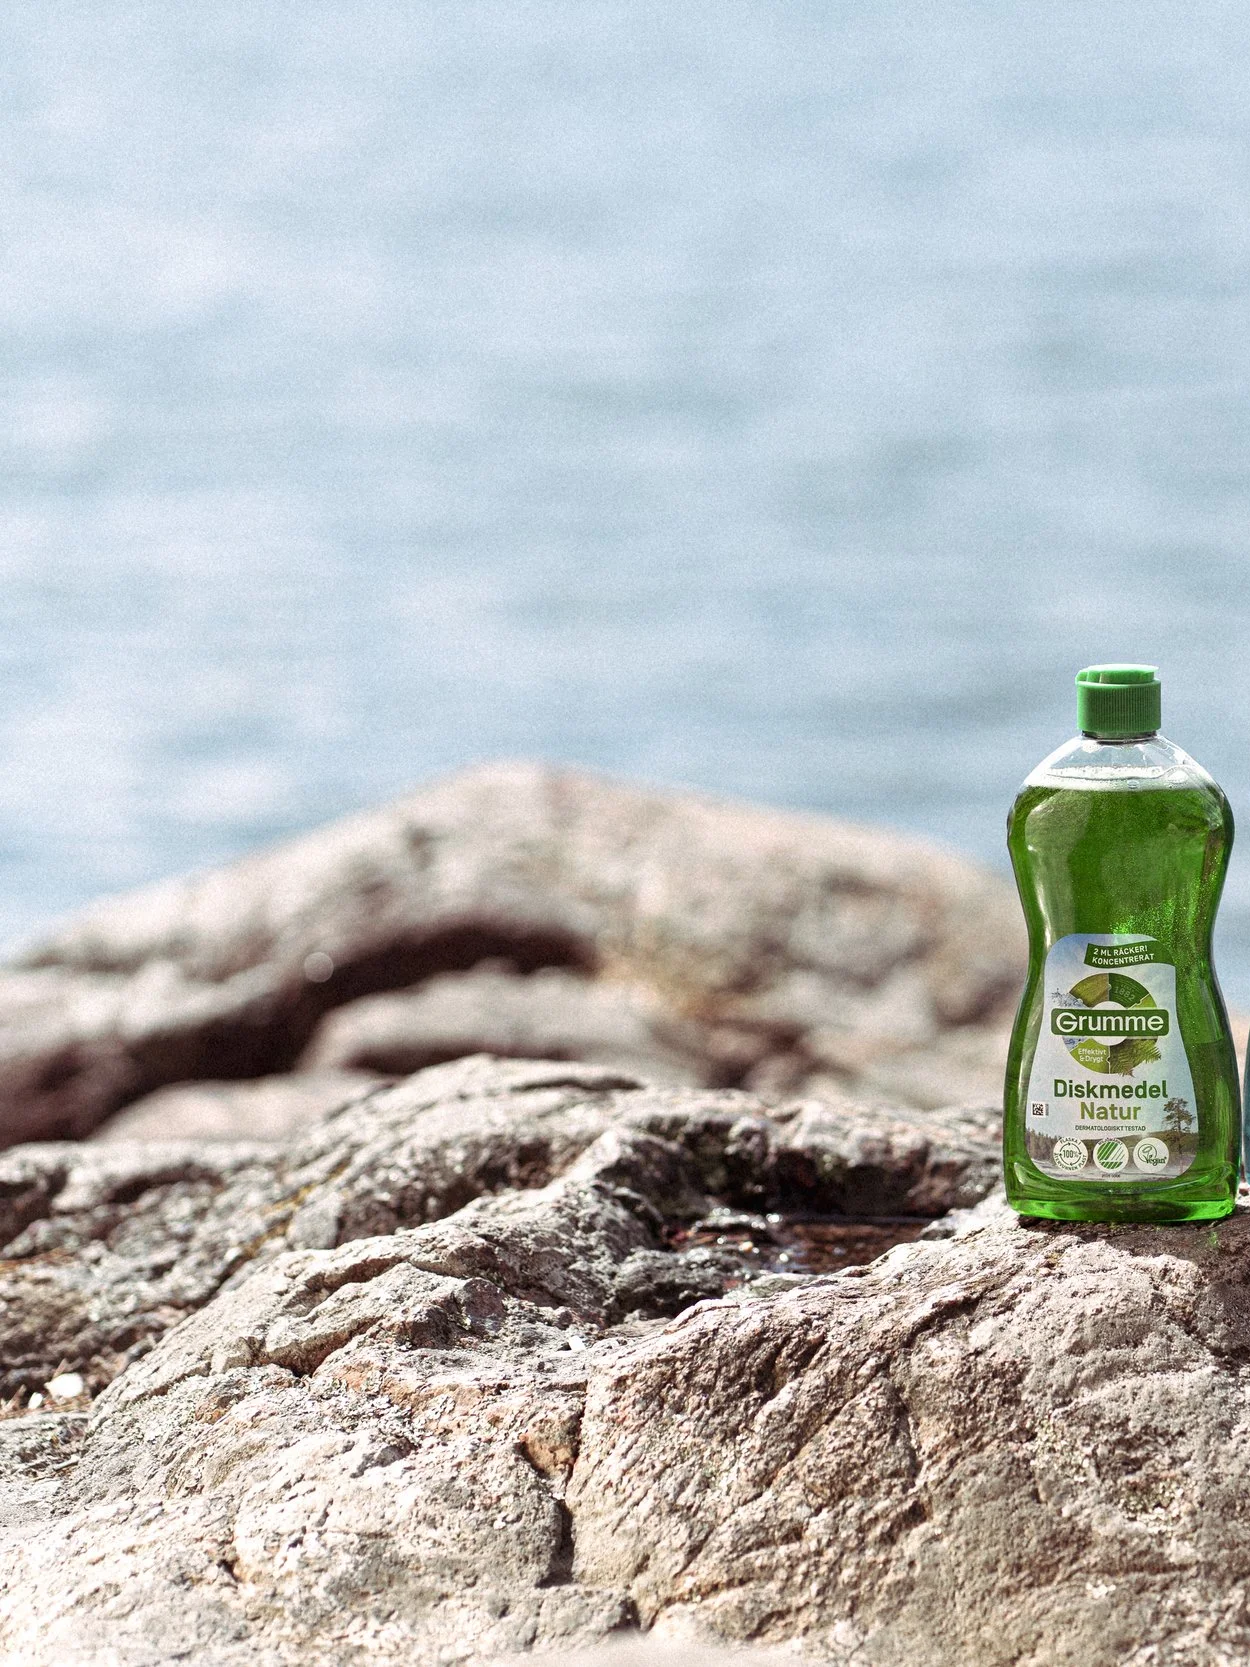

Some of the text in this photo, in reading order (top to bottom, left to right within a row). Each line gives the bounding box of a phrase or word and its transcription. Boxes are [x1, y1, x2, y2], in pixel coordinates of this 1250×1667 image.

[1092, 953, 1155, 965] KONCENTRERAT
[1114, 986, 1136, 1001] 1882
[1056, 1012, 1164, 1033] Grumme
[1053, 1079, 1168, 1099] Diskmedel
[1080, 1102, 1142, 1120] Natur
[1063, 1150, 1079, 1158] 100%
